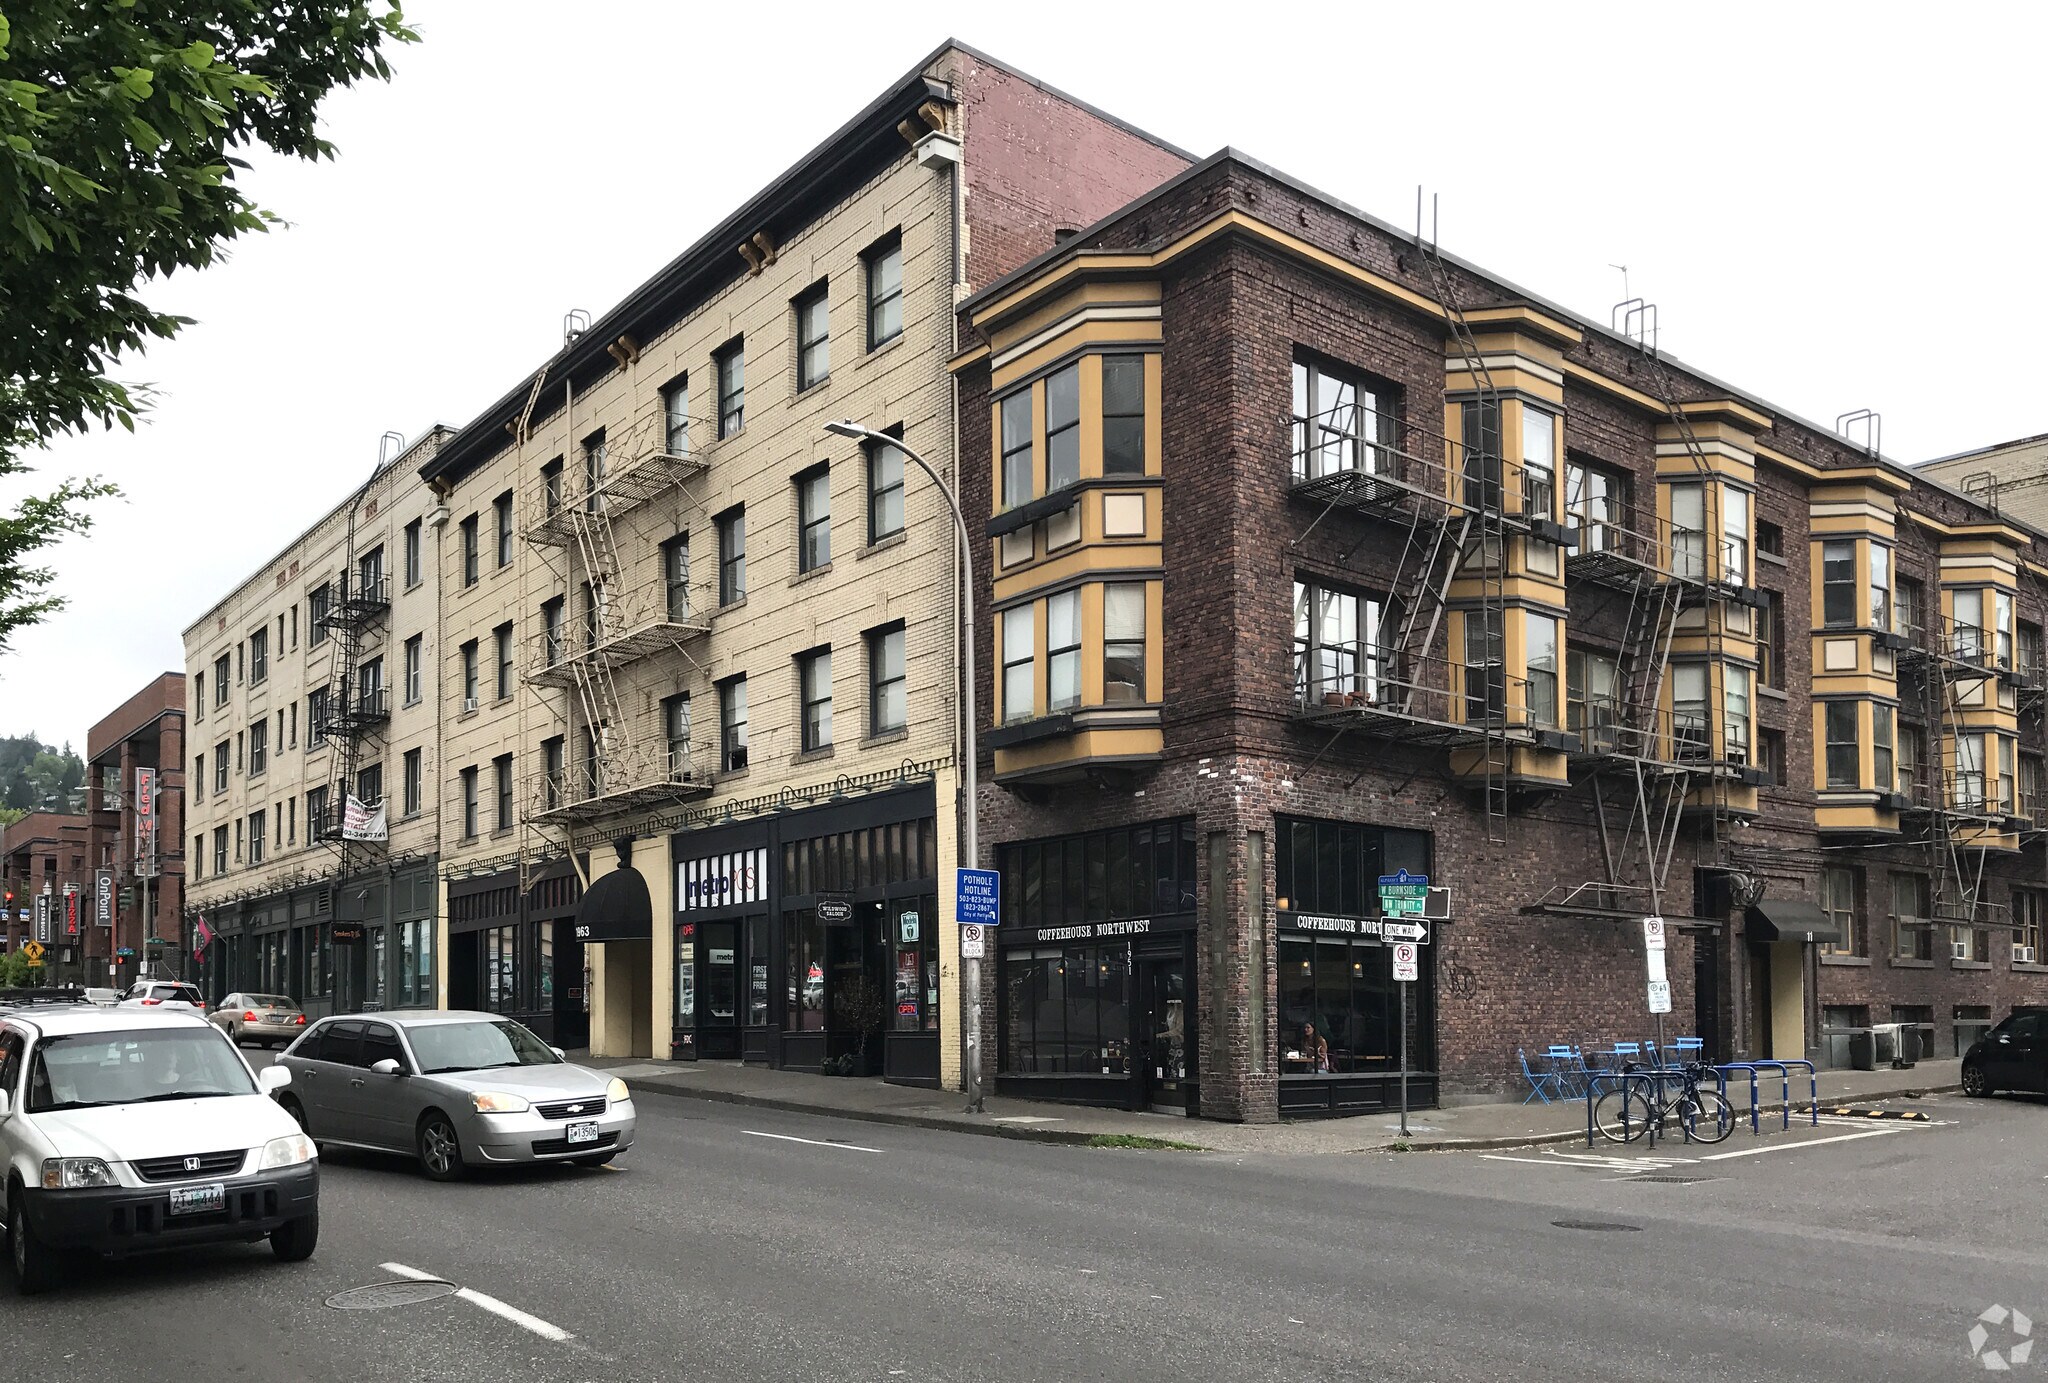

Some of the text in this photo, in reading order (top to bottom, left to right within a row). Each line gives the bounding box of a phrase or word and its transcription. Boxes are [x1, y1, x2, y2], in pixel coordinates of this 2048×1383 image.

[141, 774, 150, 815] Fred
[343, 829, 386, 839] 03-349-7741
[963, 875, 993, 886] POTHOLE
[964, 885, 992, 896] HOTLINE
[1381, 885, 1387, 895] W
[1388, 885, 1417, 895] BURNSIDE
[99, 876, 112, 920] OnPoint
[959, 895, 997, 905] 503-823-BUMP
[963, 903, 993, 912] (823-2867)
[1395, 899, 1416, 911] TRINITY
[68, 890, 76, 933] PIZZA
[1297, 915, 1356, 933] COFFEEHOUSE
[1037, 919, 1151, 941] COFFEEHOUSE NORTHWEST
[1386, 924, 1416, 936] ONE WAY
[1806, 930, 1813, 942] 11
[752, 965, 767, 974] FIRST
[752, 980, 767, 989] FREE
[899, 1005, 916, 1013] OPEN
[172, 1193, 194, 1209] ZTJ
[201, 1190, 221, 1206] 444
